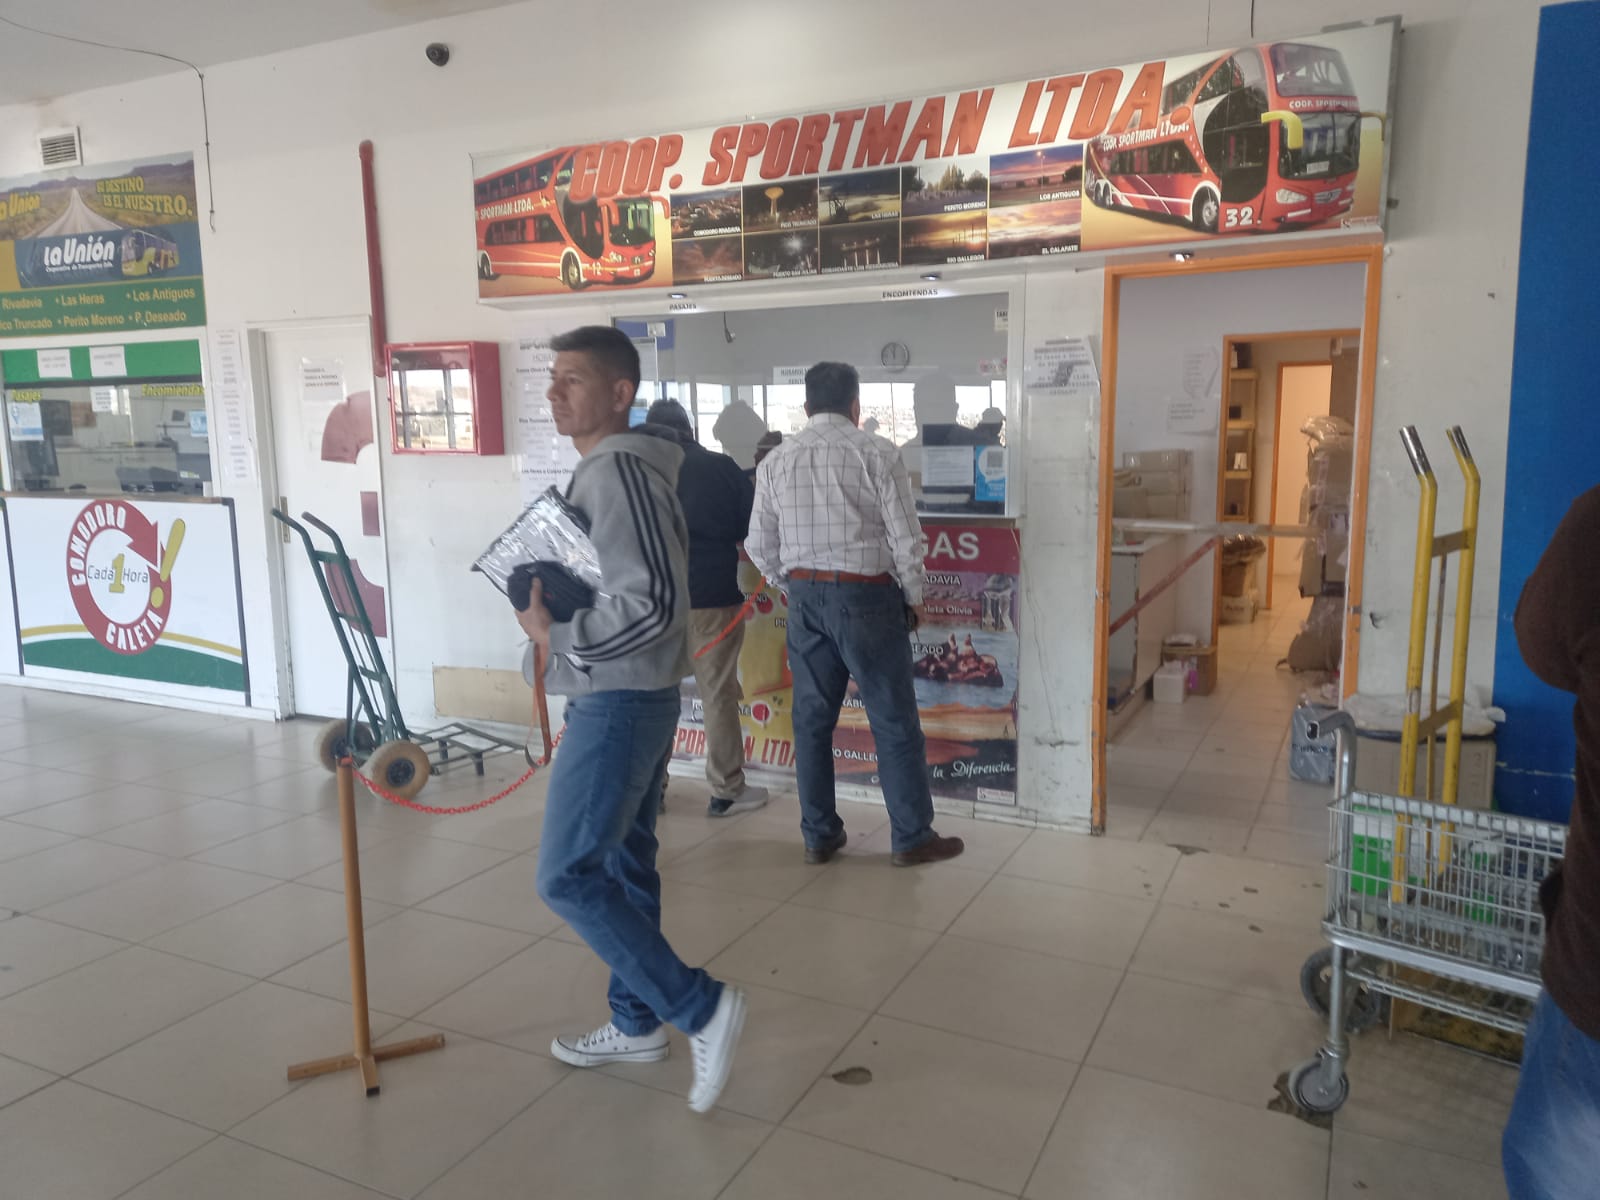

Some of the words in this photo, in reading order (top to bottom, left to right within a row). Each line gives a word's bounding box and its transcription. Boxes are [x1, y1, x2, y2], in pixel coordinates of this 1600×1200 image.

[569, 134, 683, 200] COOP.
[702, 88, 994, 186] SPORTMAN
[1008, 61, 1191, 148] LTDA.
[1118, 128, 1157, 148] SPORTMAN
[63, 234, 116, 264] Unión
[133, 289, 150, 300] Los
[152, 287, 196, 303] Antiguos
[882, 288, 938, 298] ENCOMIENDAS
[669, 303, 696, 311] PASAJES
[146, 310, 187, 323] Deseado
[142, 383, 204, 398] Encomiendas
[70, 503, 126, 586] COMODORO
[87, 565, 114, 580] Cada
[109, 553, 125, 593] 1
[123, 566, 149, 583] Hora
[105, 609, 164, 650] CALETA
[933, 765, 944, 778] la
